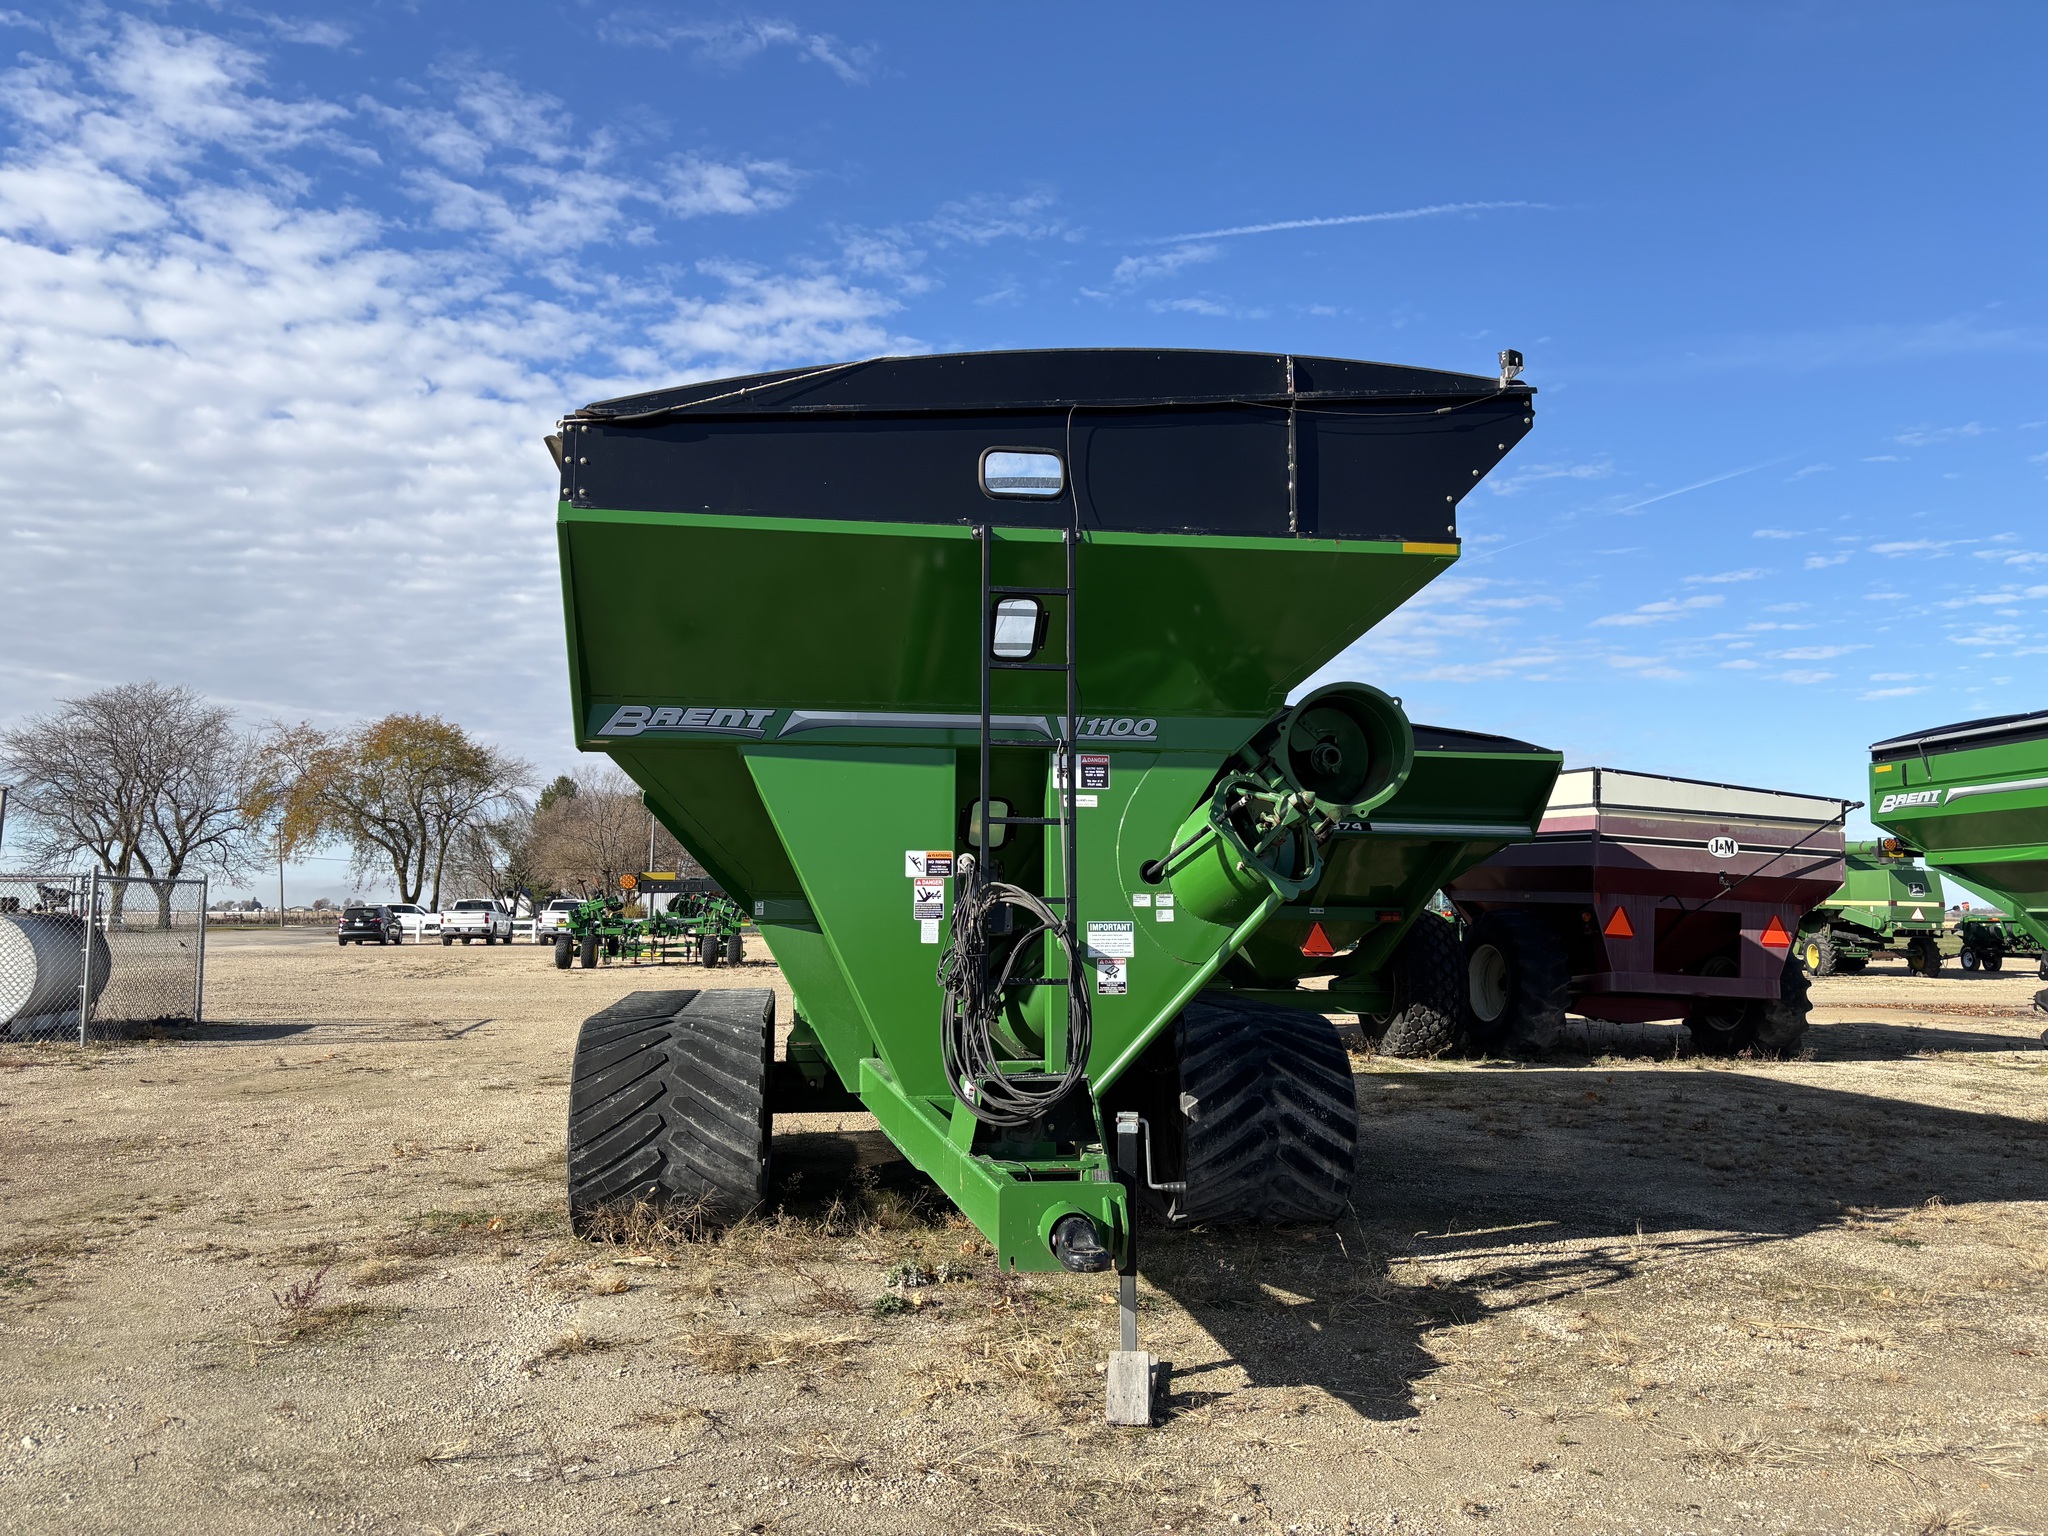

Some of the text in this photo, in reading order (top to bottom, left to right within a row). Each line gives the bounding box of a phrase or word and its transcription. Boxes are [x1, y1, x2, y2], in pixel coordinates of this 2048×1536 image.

[596, 705, 776, 738] BRENT
[1878, 789, 1942, 814] BRENT
[1710, 839, 1735, 854] J&M
[1090, 923, 1131, 931] IMPORTANT
